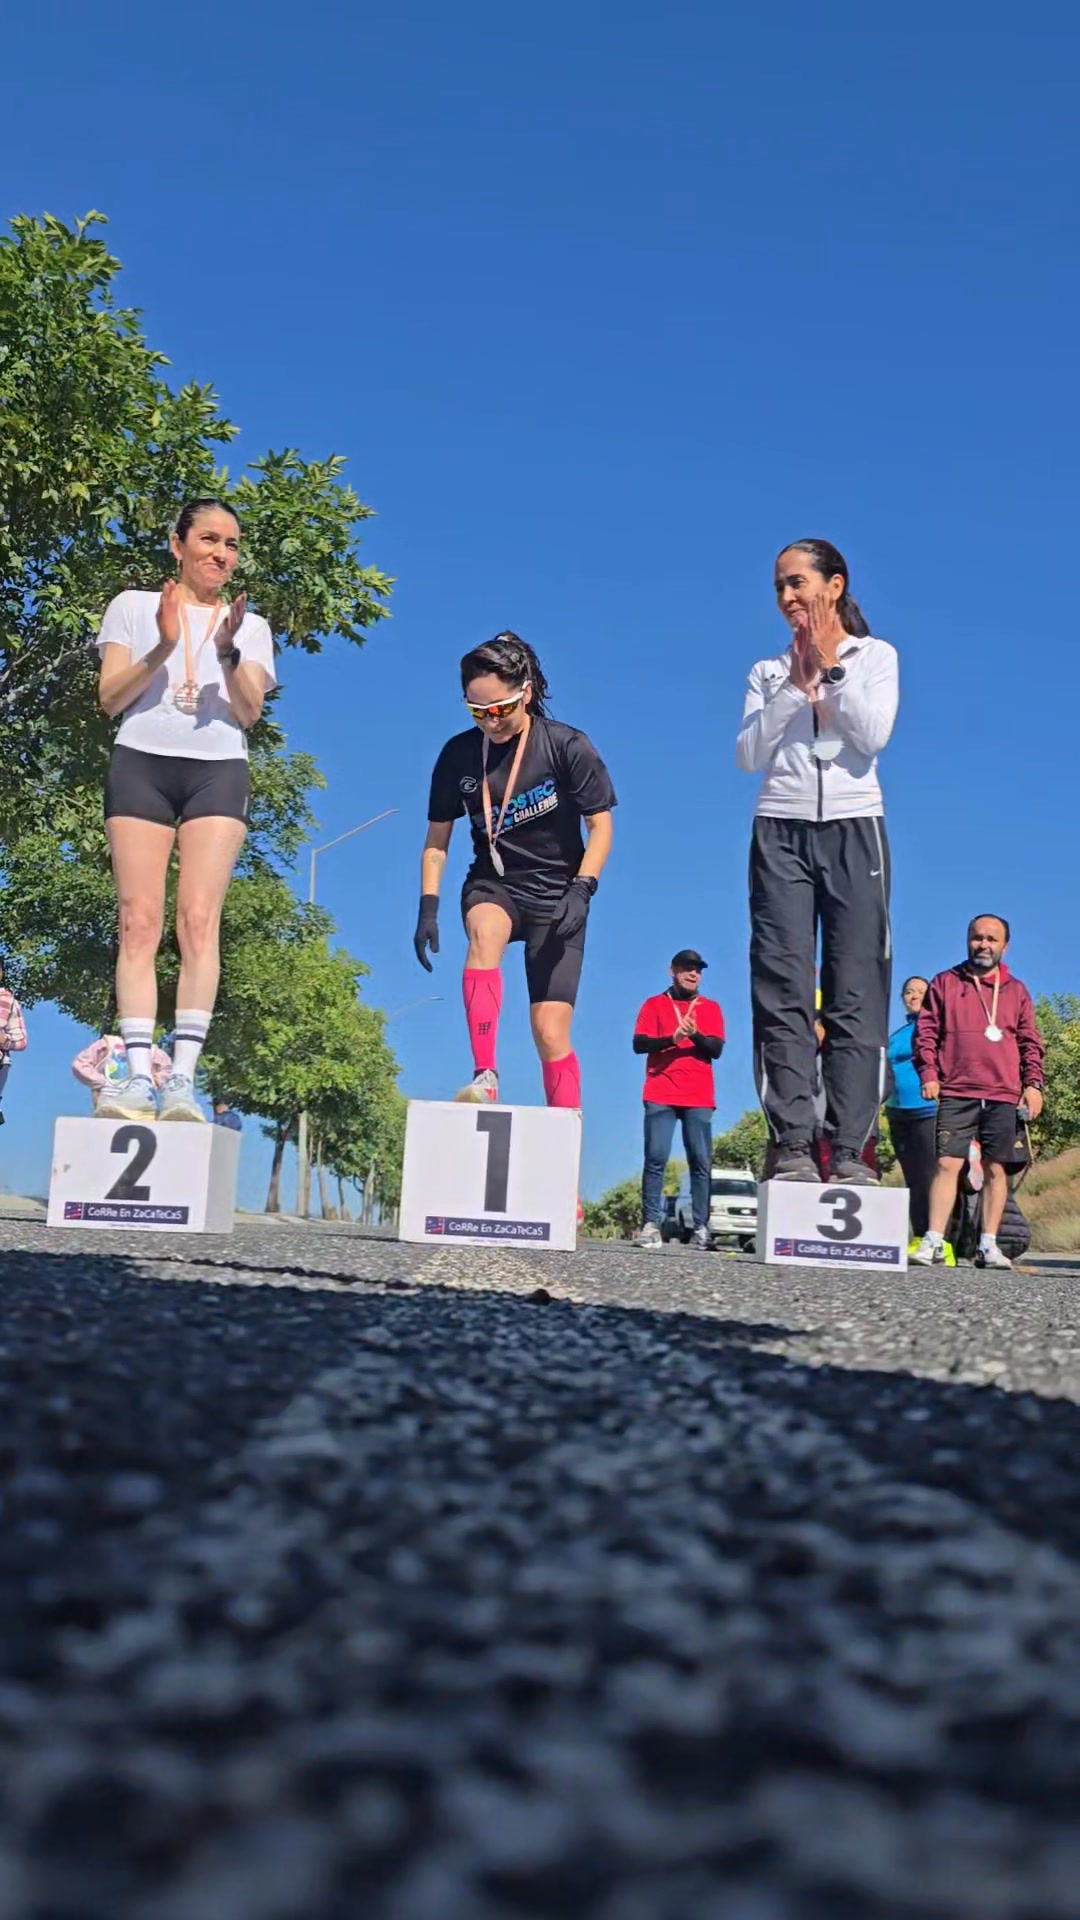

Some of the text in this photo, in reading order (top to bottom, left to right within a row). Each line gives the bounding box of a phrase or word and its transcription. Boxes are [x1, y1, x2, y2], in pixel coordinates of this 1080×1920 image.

[513, 792, 558, 823] CHALLENGE
[104, 1125, 157, 1201] 2
[476, 1110, 513, 1213] 1
[119, 1208, 131, 1218] En
[480, 1223, 492, 1233] En
[816, 1188, 862, 1241] 3
[829, 1245, 841, 1256] En
